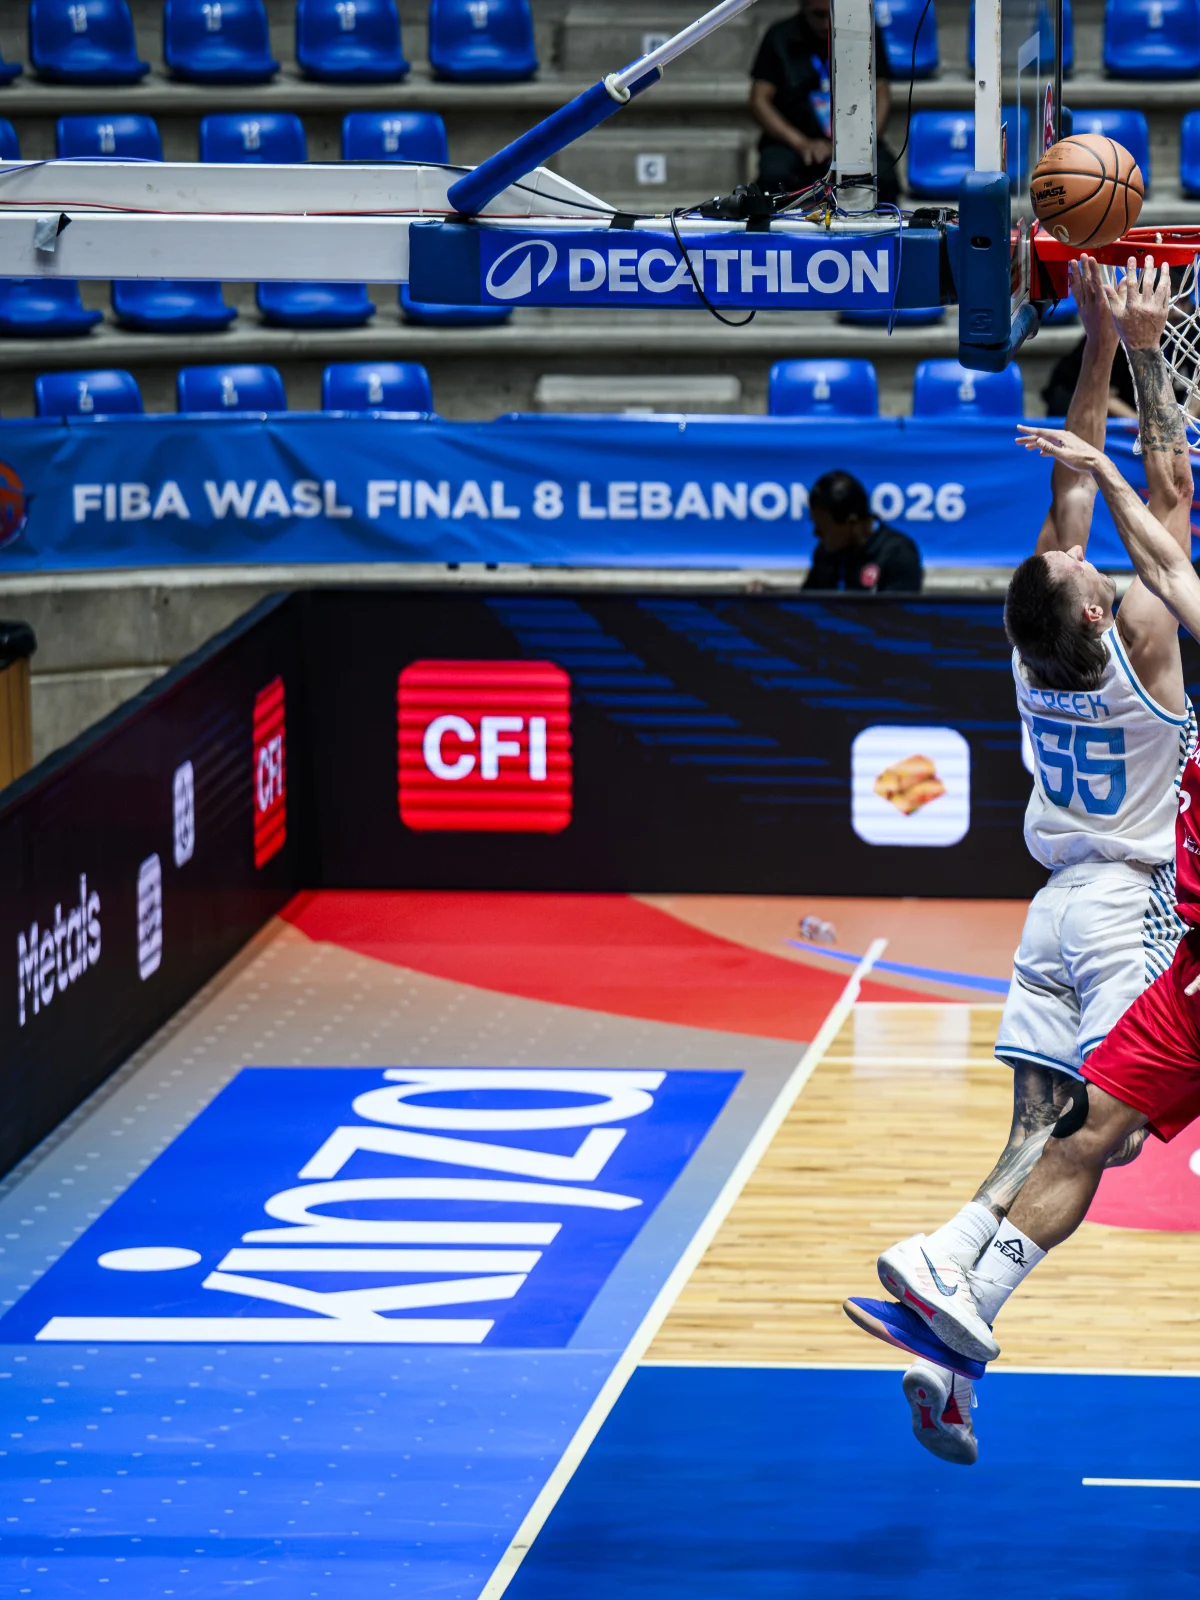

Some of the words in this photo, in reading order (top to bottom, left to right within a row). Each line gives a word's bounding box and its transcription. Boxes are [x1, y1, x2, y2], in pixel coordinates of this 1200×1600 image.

[568, 247, 890, 295] DECATHLON
[73, 483, 190, 523] FIBA
[204, 480, 353, 520] WASL
[366, 480, 521, 520] FINAL
[532, 480, 564, 521] 8
[870, 481, 967, 522] 026
[256, 734, 284, 812] CFI
[422, 715, 548, 781] CFI
[1032, 715, 1127, 815] 55
[17, 872, 102, 1027] Metals
[35, 1069, 668, 1344] kinza
[993, 1239, 1029, 1269] PEAK
